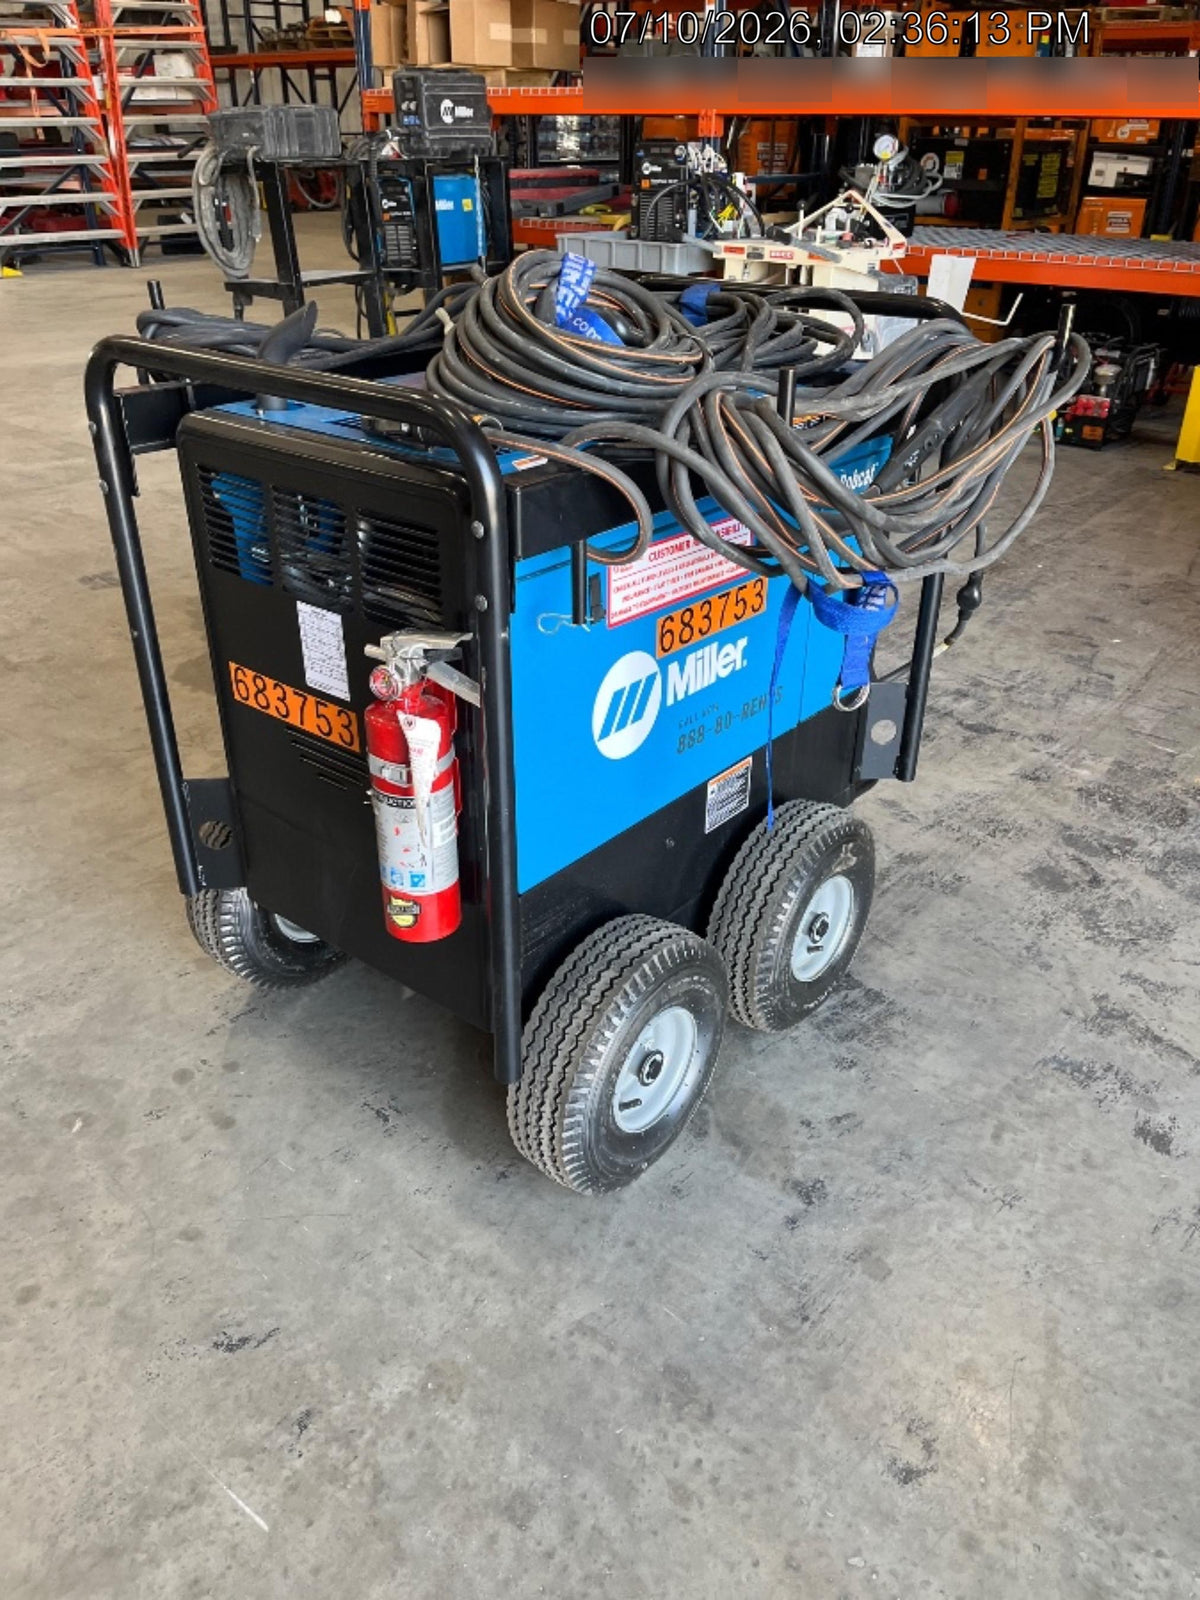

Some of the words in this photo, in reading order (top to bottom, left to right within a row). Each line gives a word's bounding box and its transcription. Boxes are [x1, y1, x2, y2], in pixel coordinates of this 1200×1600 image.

[648, 539, 691, 562] CUSTOMER
[661, 578, 765, 654] 683753
[234, 666, 354, 747] 683753
[677, 686, 784, 753] 888-80-RENS
